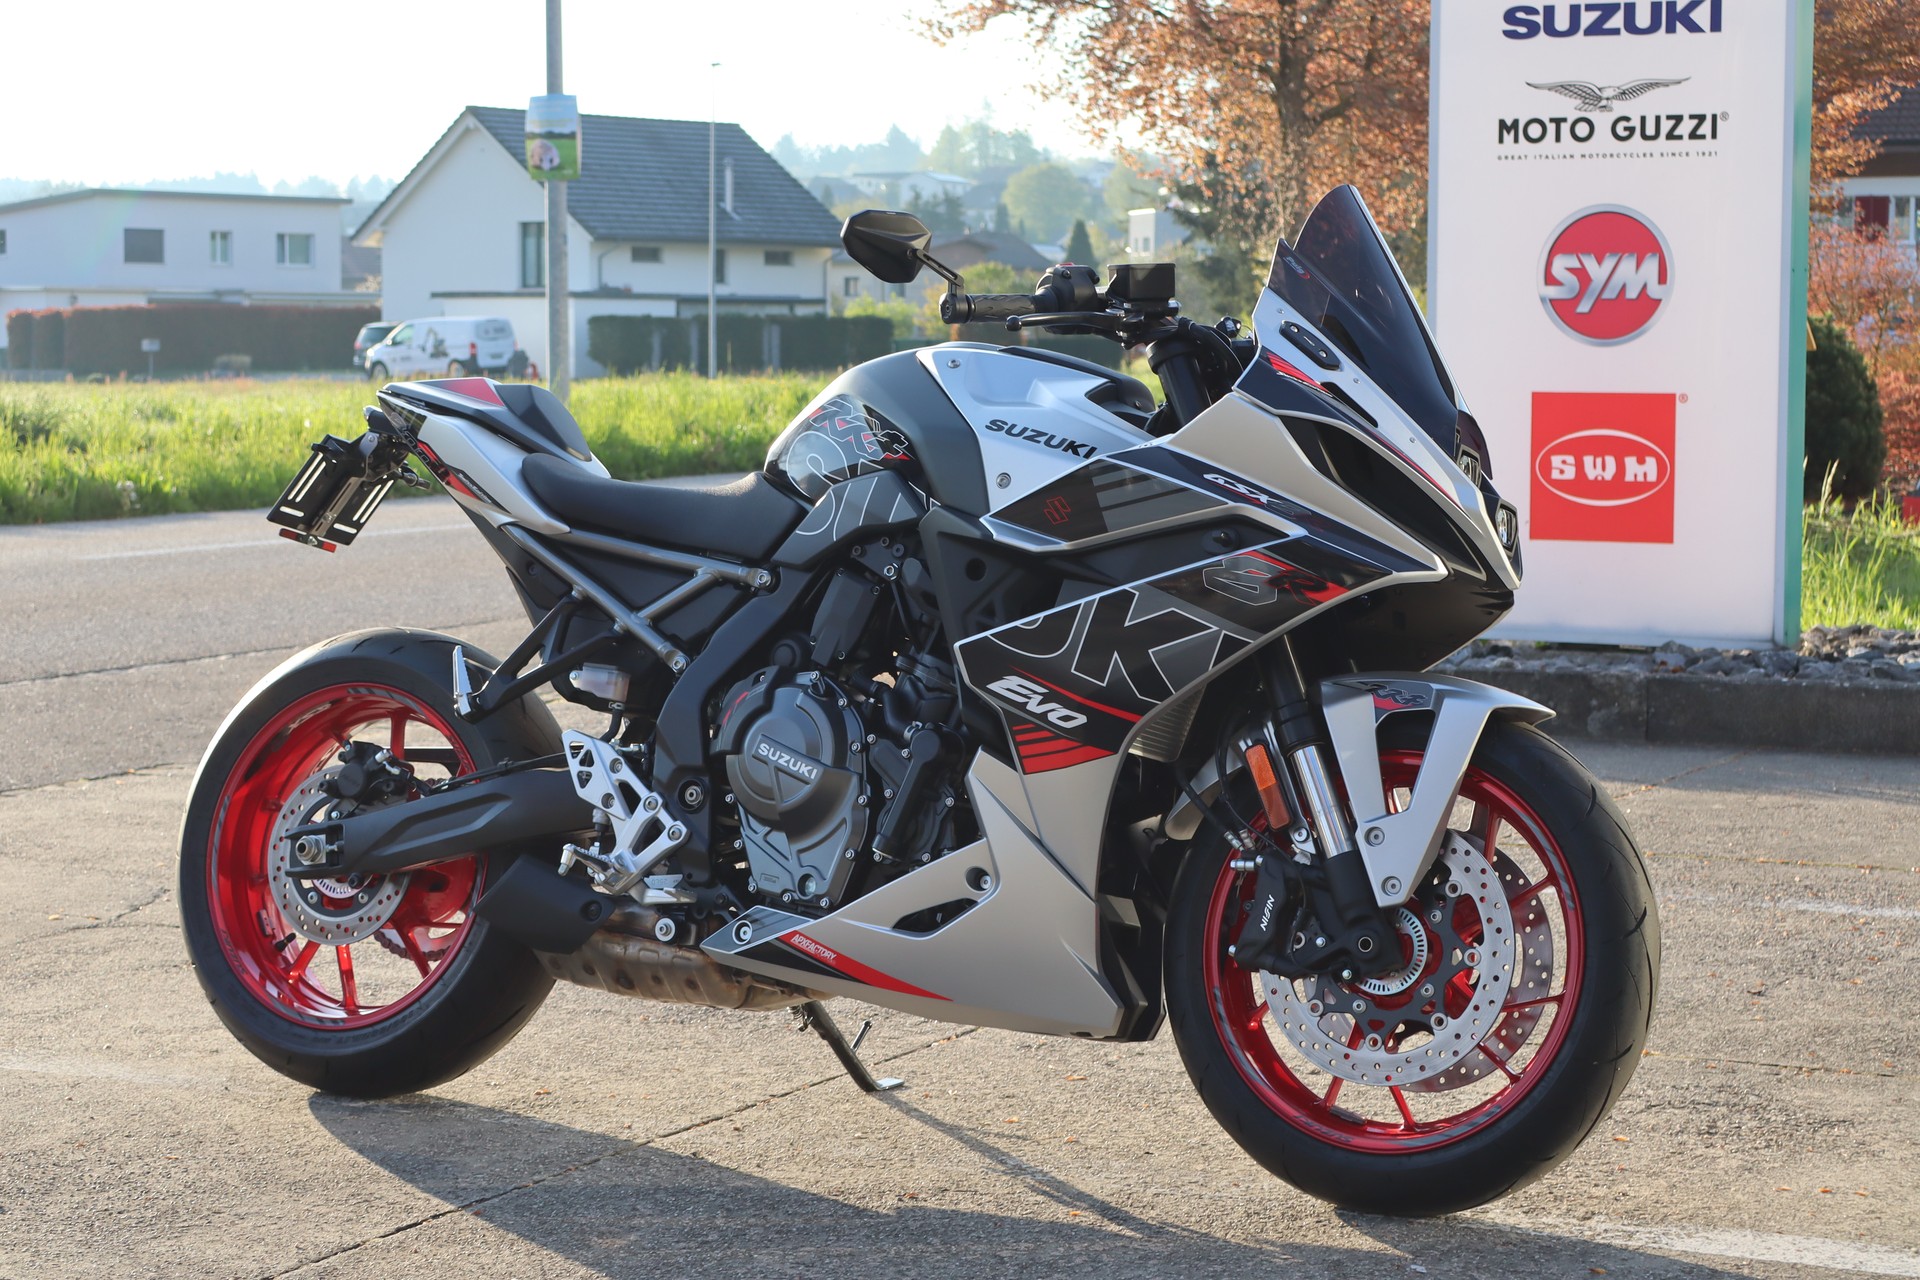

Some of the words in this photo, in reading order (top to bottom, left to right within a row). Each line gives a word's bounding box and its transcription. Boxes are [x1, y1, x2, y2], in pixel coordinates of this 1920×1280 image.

[1502, 0, 1723, 40] SUZUKI
[1498, 116, 1595, 145] MOTO
[1610, 113, 1718, 141] GUZZI
[1580, 152, 1654, 160] MOTORCYCLES
[1540, 252, 1668, 314] SYM
[984, 418, 1098, 460] SUZUKI
[1550, 454, 1658, 482] SWM
[757, 742, 818, 780] SUZUKI
